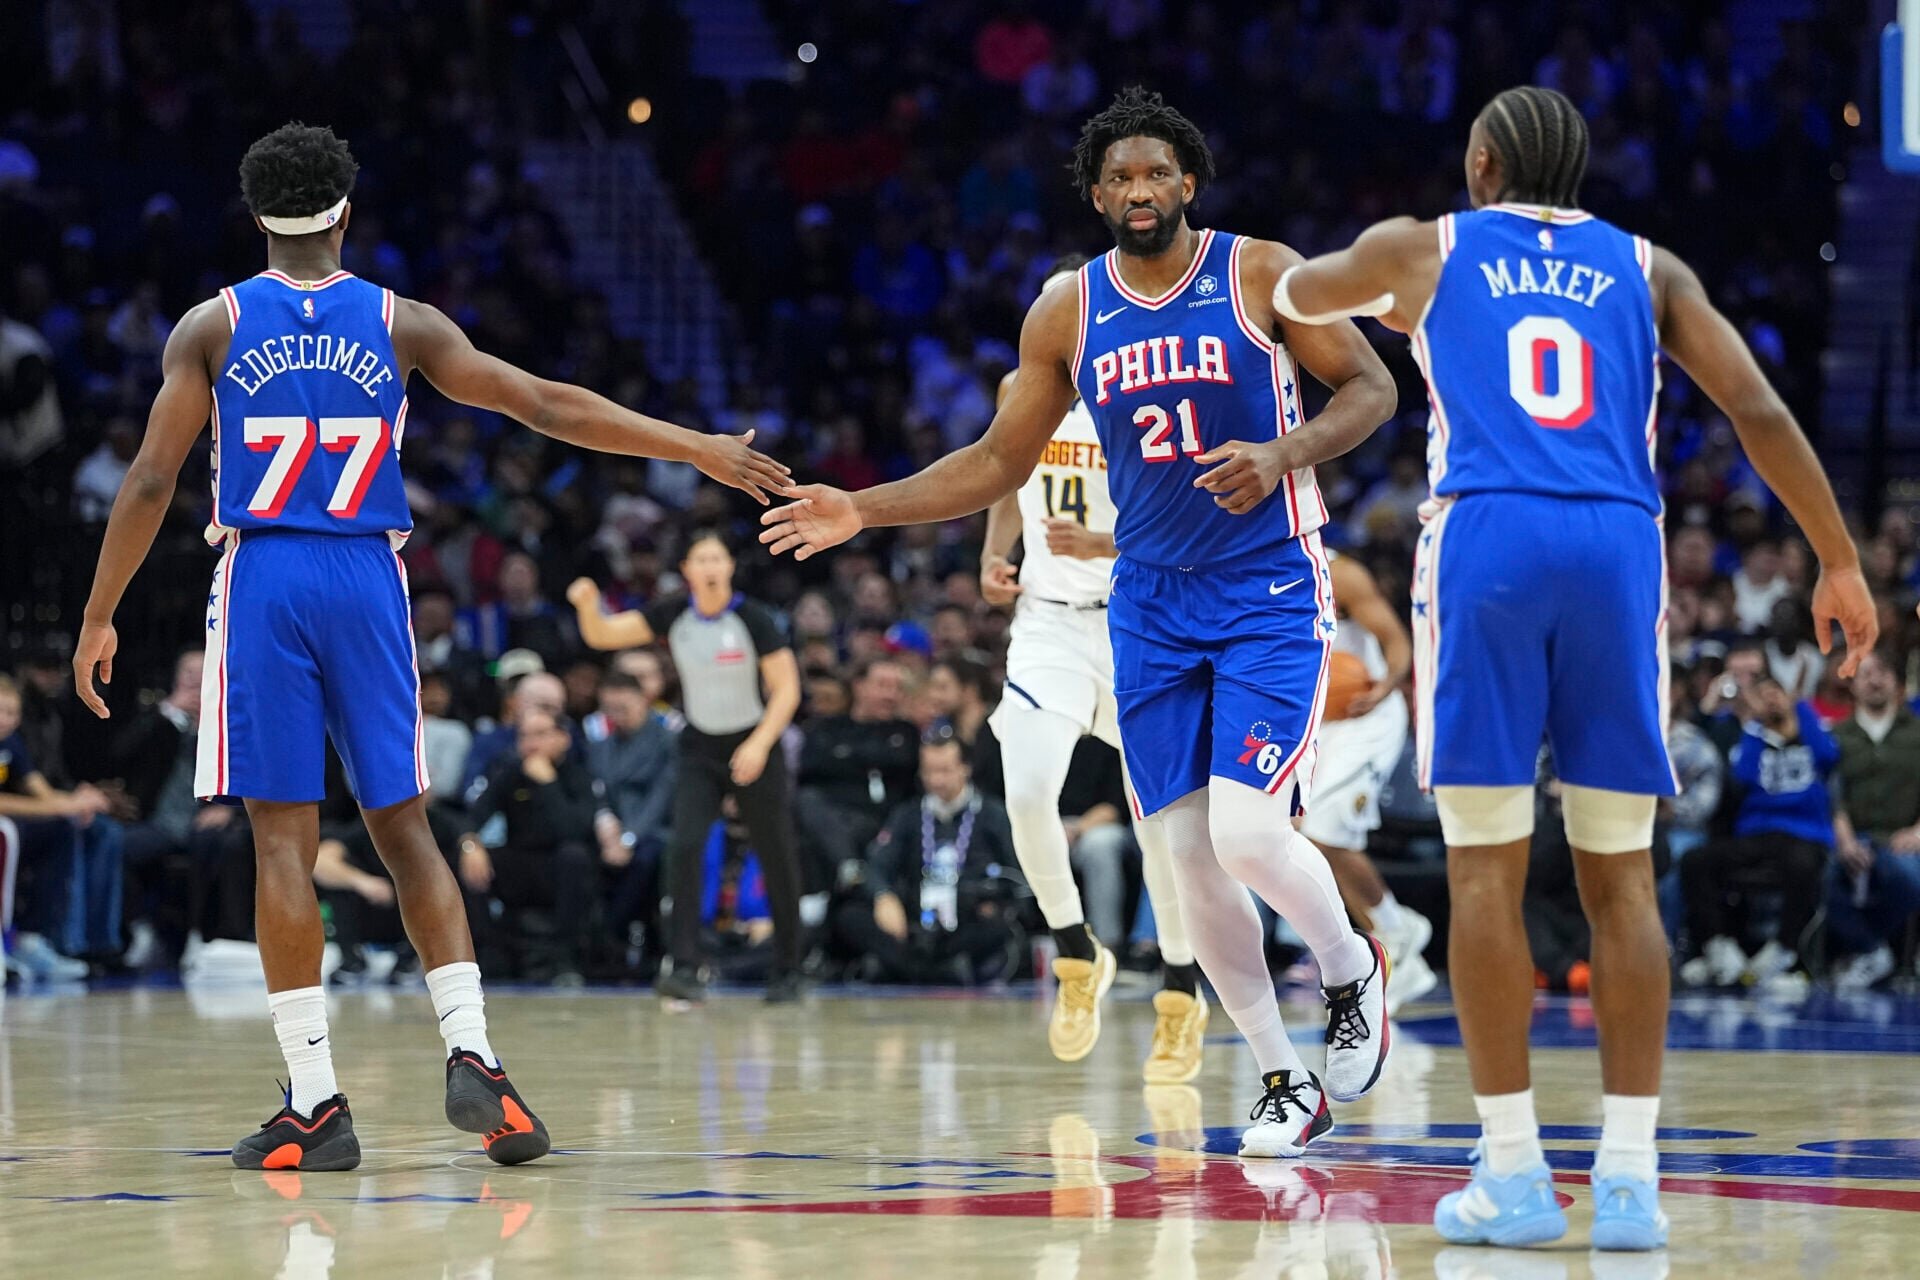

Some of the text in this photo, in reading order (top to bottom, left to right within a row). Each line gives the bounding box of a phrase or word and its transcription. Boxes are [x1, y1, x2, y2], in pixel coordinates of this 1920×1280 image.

[1188, 297, 1227, 308] crypto.com
[1479, 258, 1616, 308] MAXEY
[226, 335, 393, 398] EDGECOMBE
[1093, 335, 1233, 406] PHILA
[1507, 315, 1595, 429] 0
[1041, 440, 1108, 470] GGET
[1132, 398, 1205, 463] 21
[243, 416, 391, 518] 77
[1042, 473, 1088, 528] 14
[1236, 732, 1282, 775] 76
